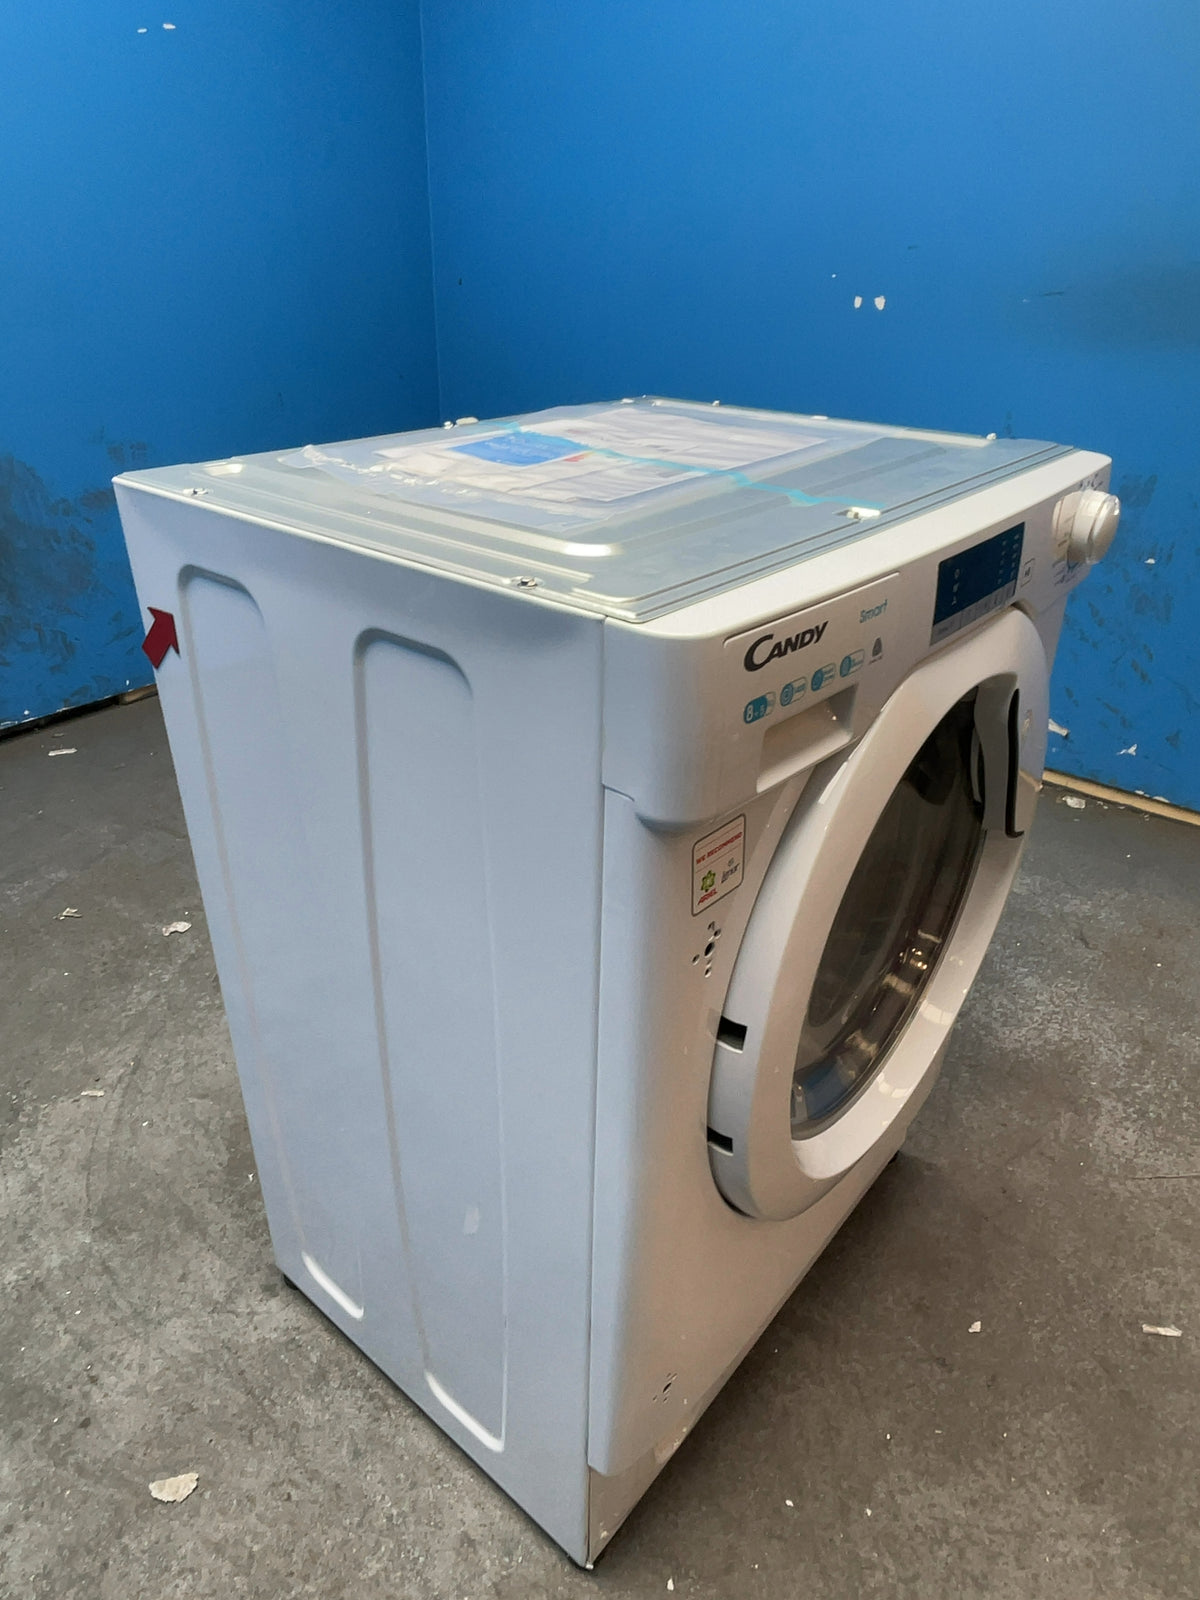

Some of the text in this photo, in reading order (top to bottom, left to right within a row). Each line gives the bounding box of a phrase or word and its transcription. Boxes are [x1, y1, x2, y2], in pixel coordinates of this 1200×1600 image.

[859, 599, 888, 624] Smart
[744, 621, 829, 672] CANDY
[696, 831, 743, 865] WE RECOMMEND
